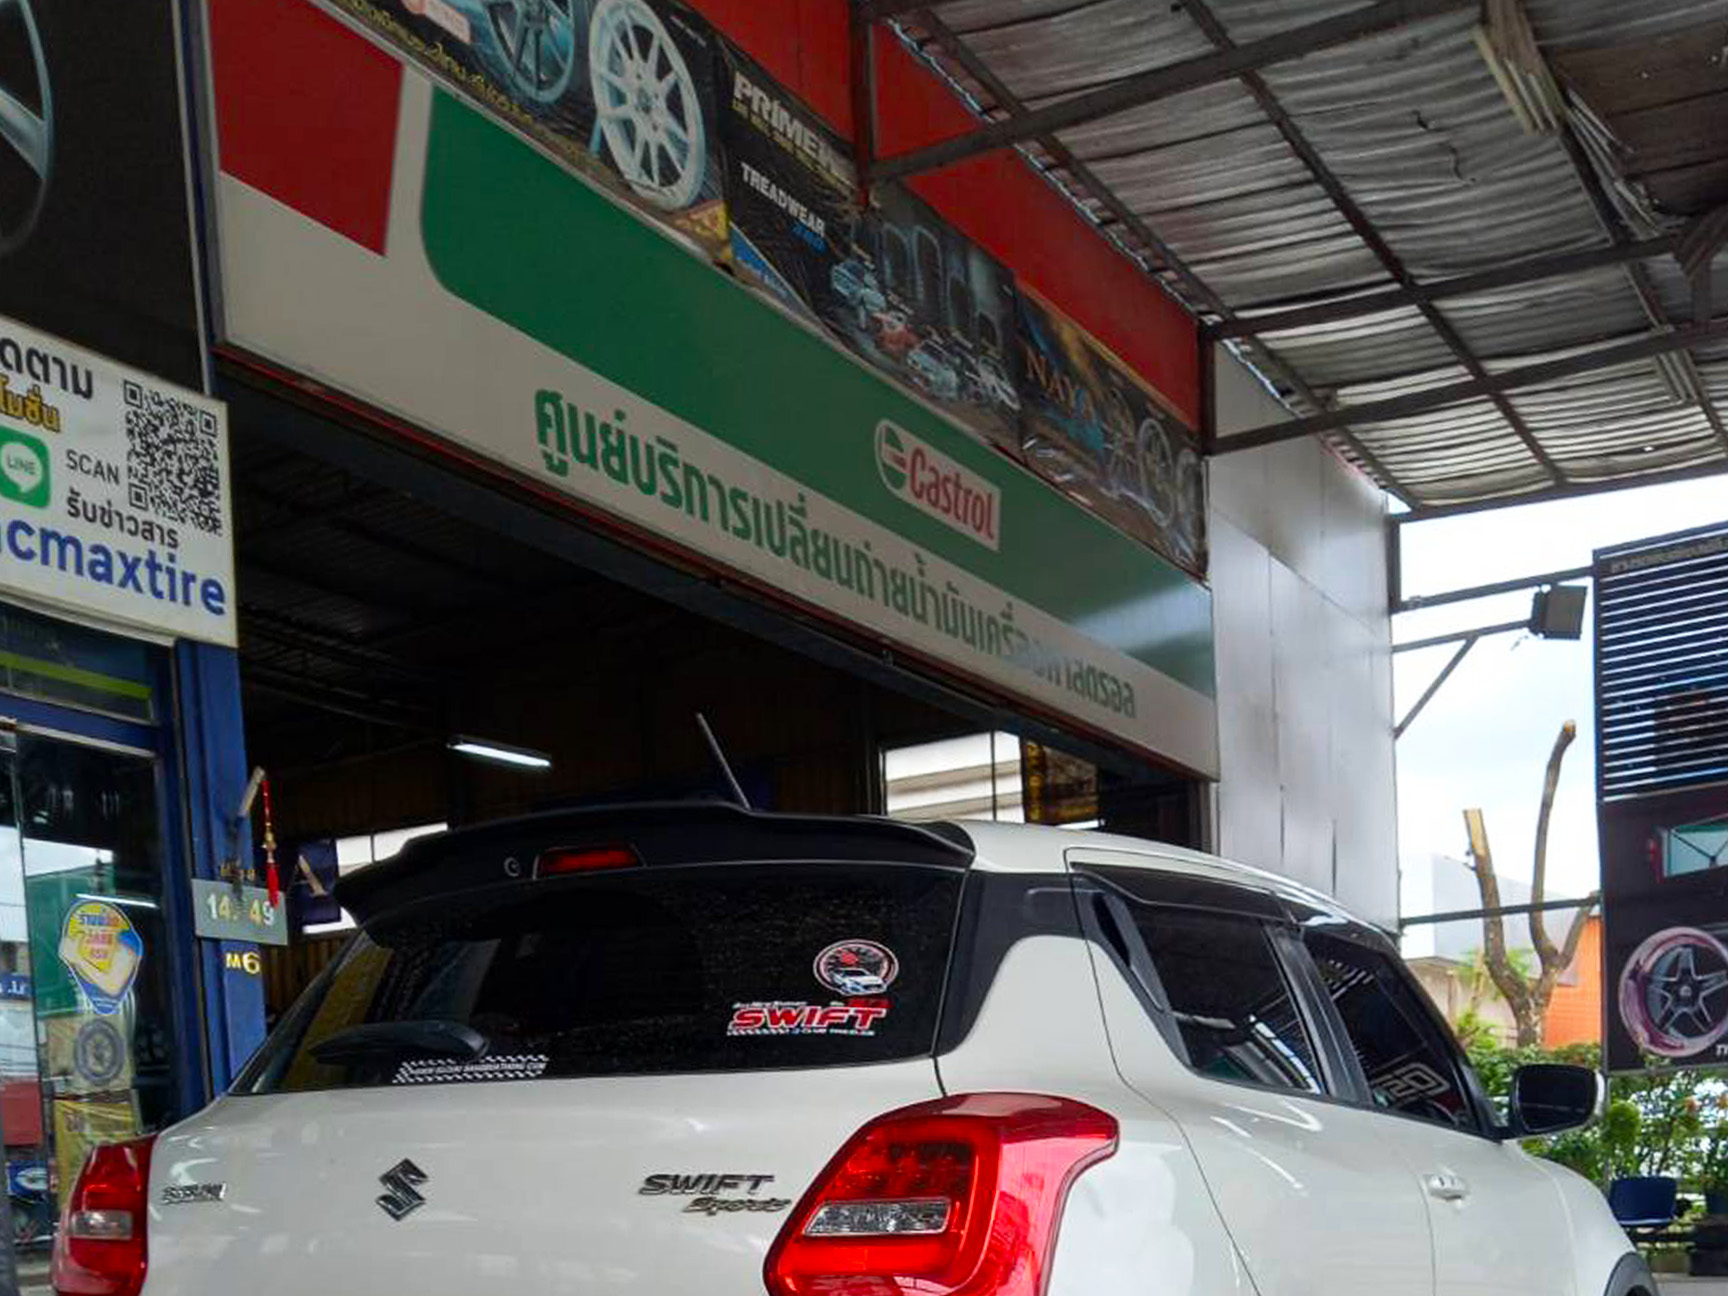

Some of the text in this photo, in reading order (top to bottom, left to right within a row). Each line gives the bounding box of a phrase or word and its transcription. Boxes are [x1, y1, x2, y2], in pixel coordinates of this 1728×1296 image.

[6, 454, 36, 477] LINE
[66, 449, 120, 485] SCAN
[910, 446, 995, 541] Castrol
[66, 486, 179, 549] รับข่าวสาร
[2, 519, 226, 616] cmaxtire
[728, 1005, 887, 1031] SWIFT
[639, 1173, 775, 1196] SWIFT
